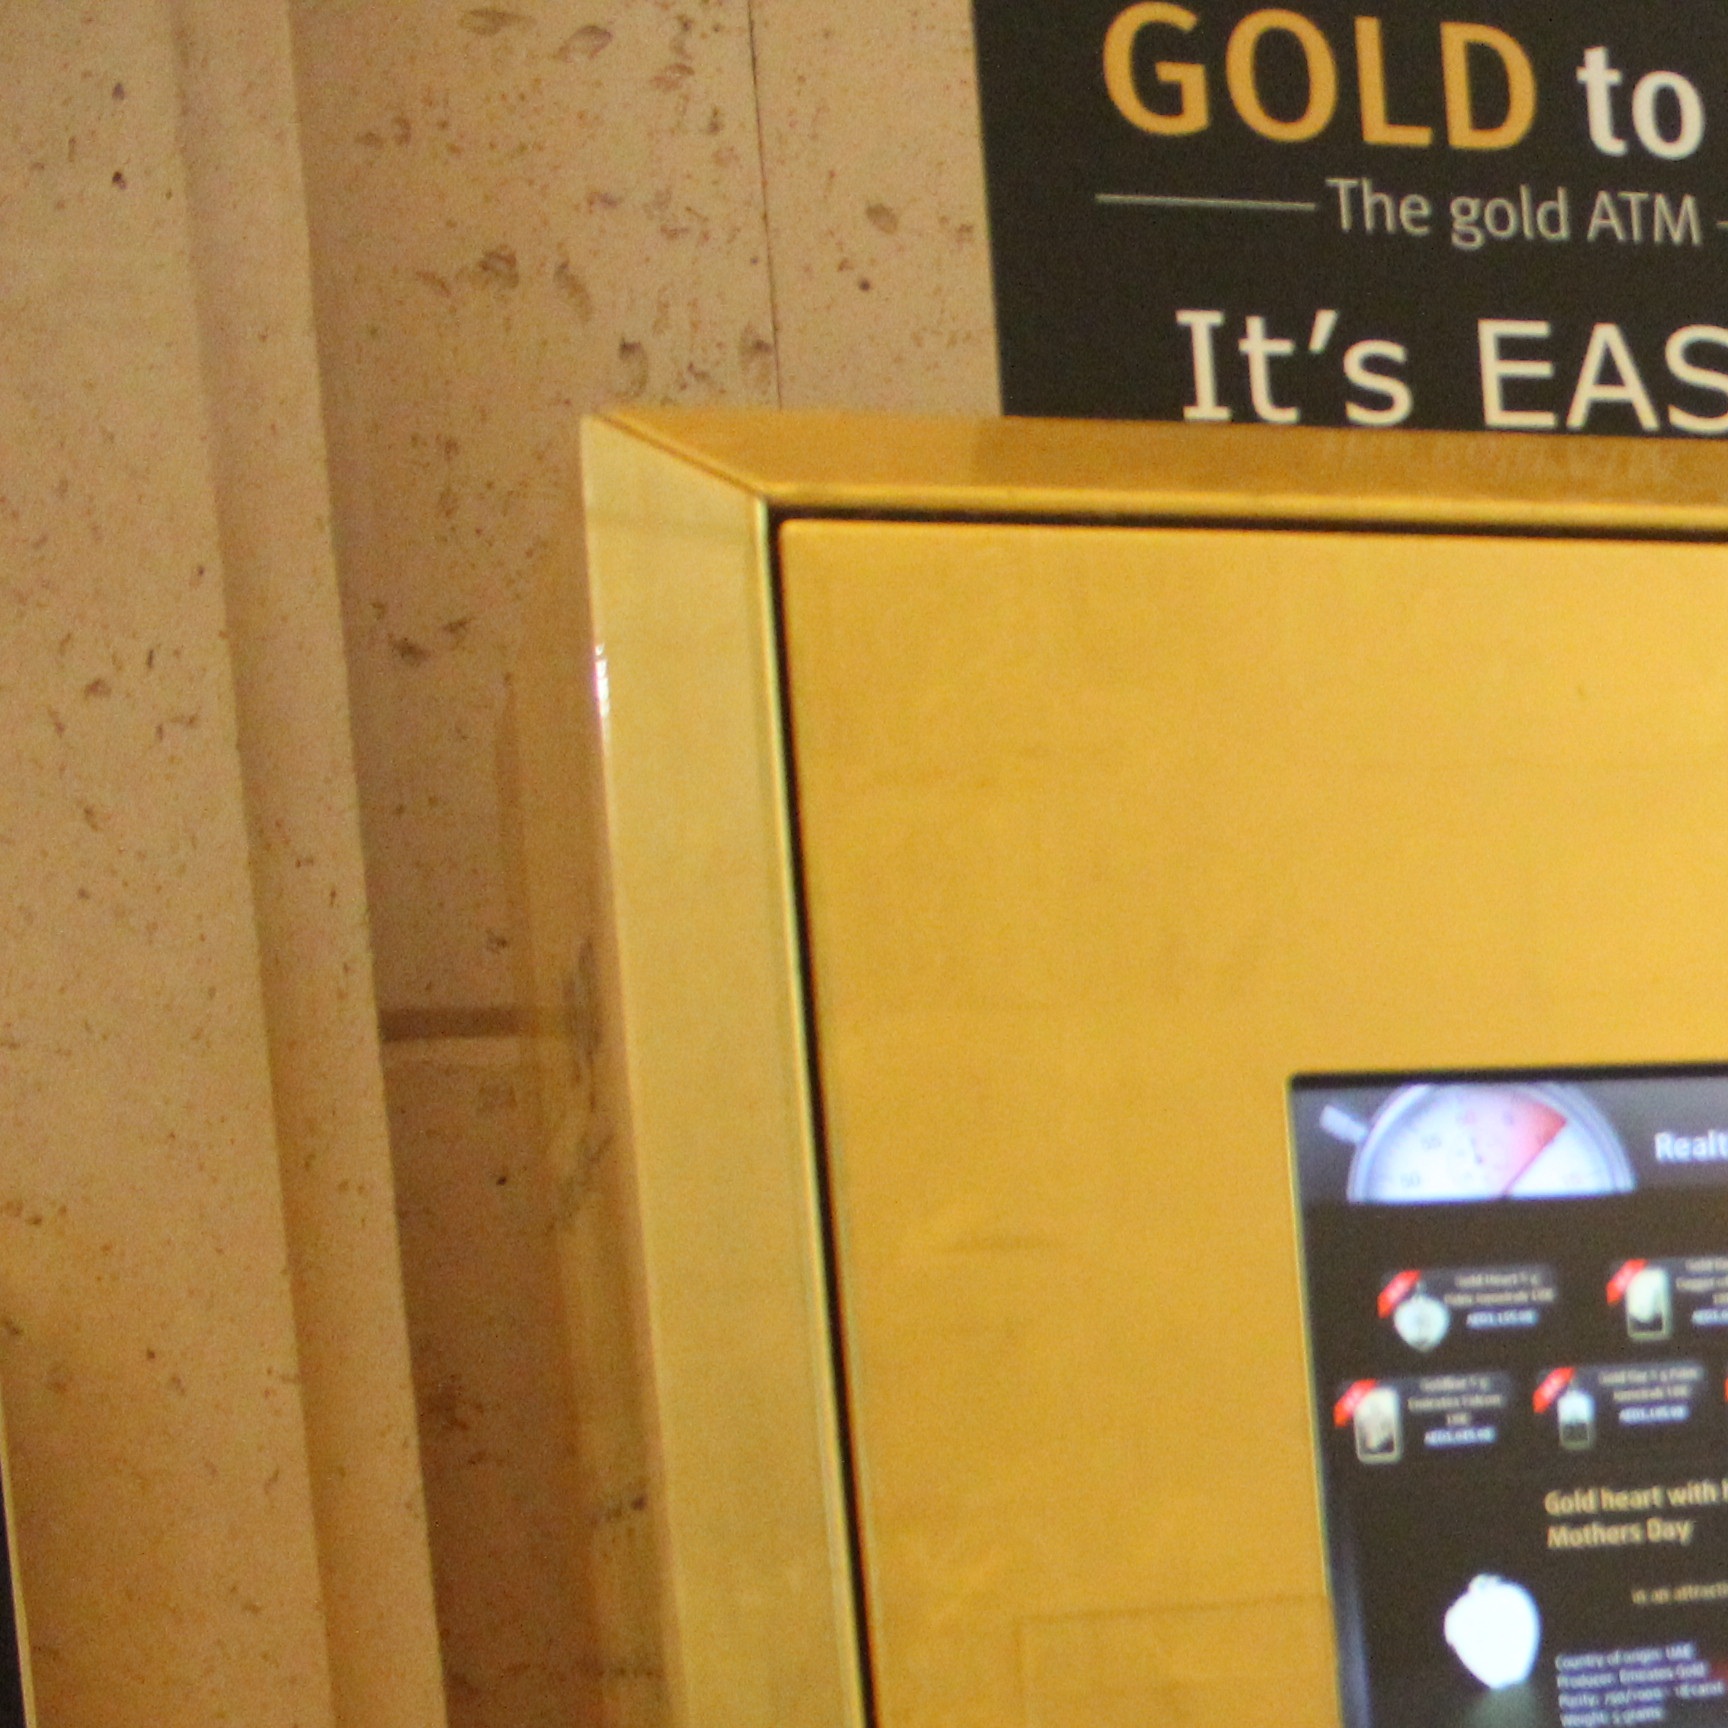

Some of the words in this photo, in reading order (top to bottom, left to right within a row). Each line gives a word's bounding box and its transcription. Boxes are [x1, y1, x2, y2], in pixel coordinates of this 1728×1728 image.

[1101, 0, 1538, 151] GOLD
[1576, 46, 1706, 159] to
[1325, 177, 1432, 237] The
[1450, 186, 1570, 252] gold
[1586, 191, 1703, 246] ATM
[1544, 1488, 1598, 1516] Gold
[1599, 1484, 1665, 1512] heart
[1667, 1480, 1717, 1508] with
[1546, 1522, 1644, 1549] Mothers
[1646, 1517, 1695, 1546] Day
